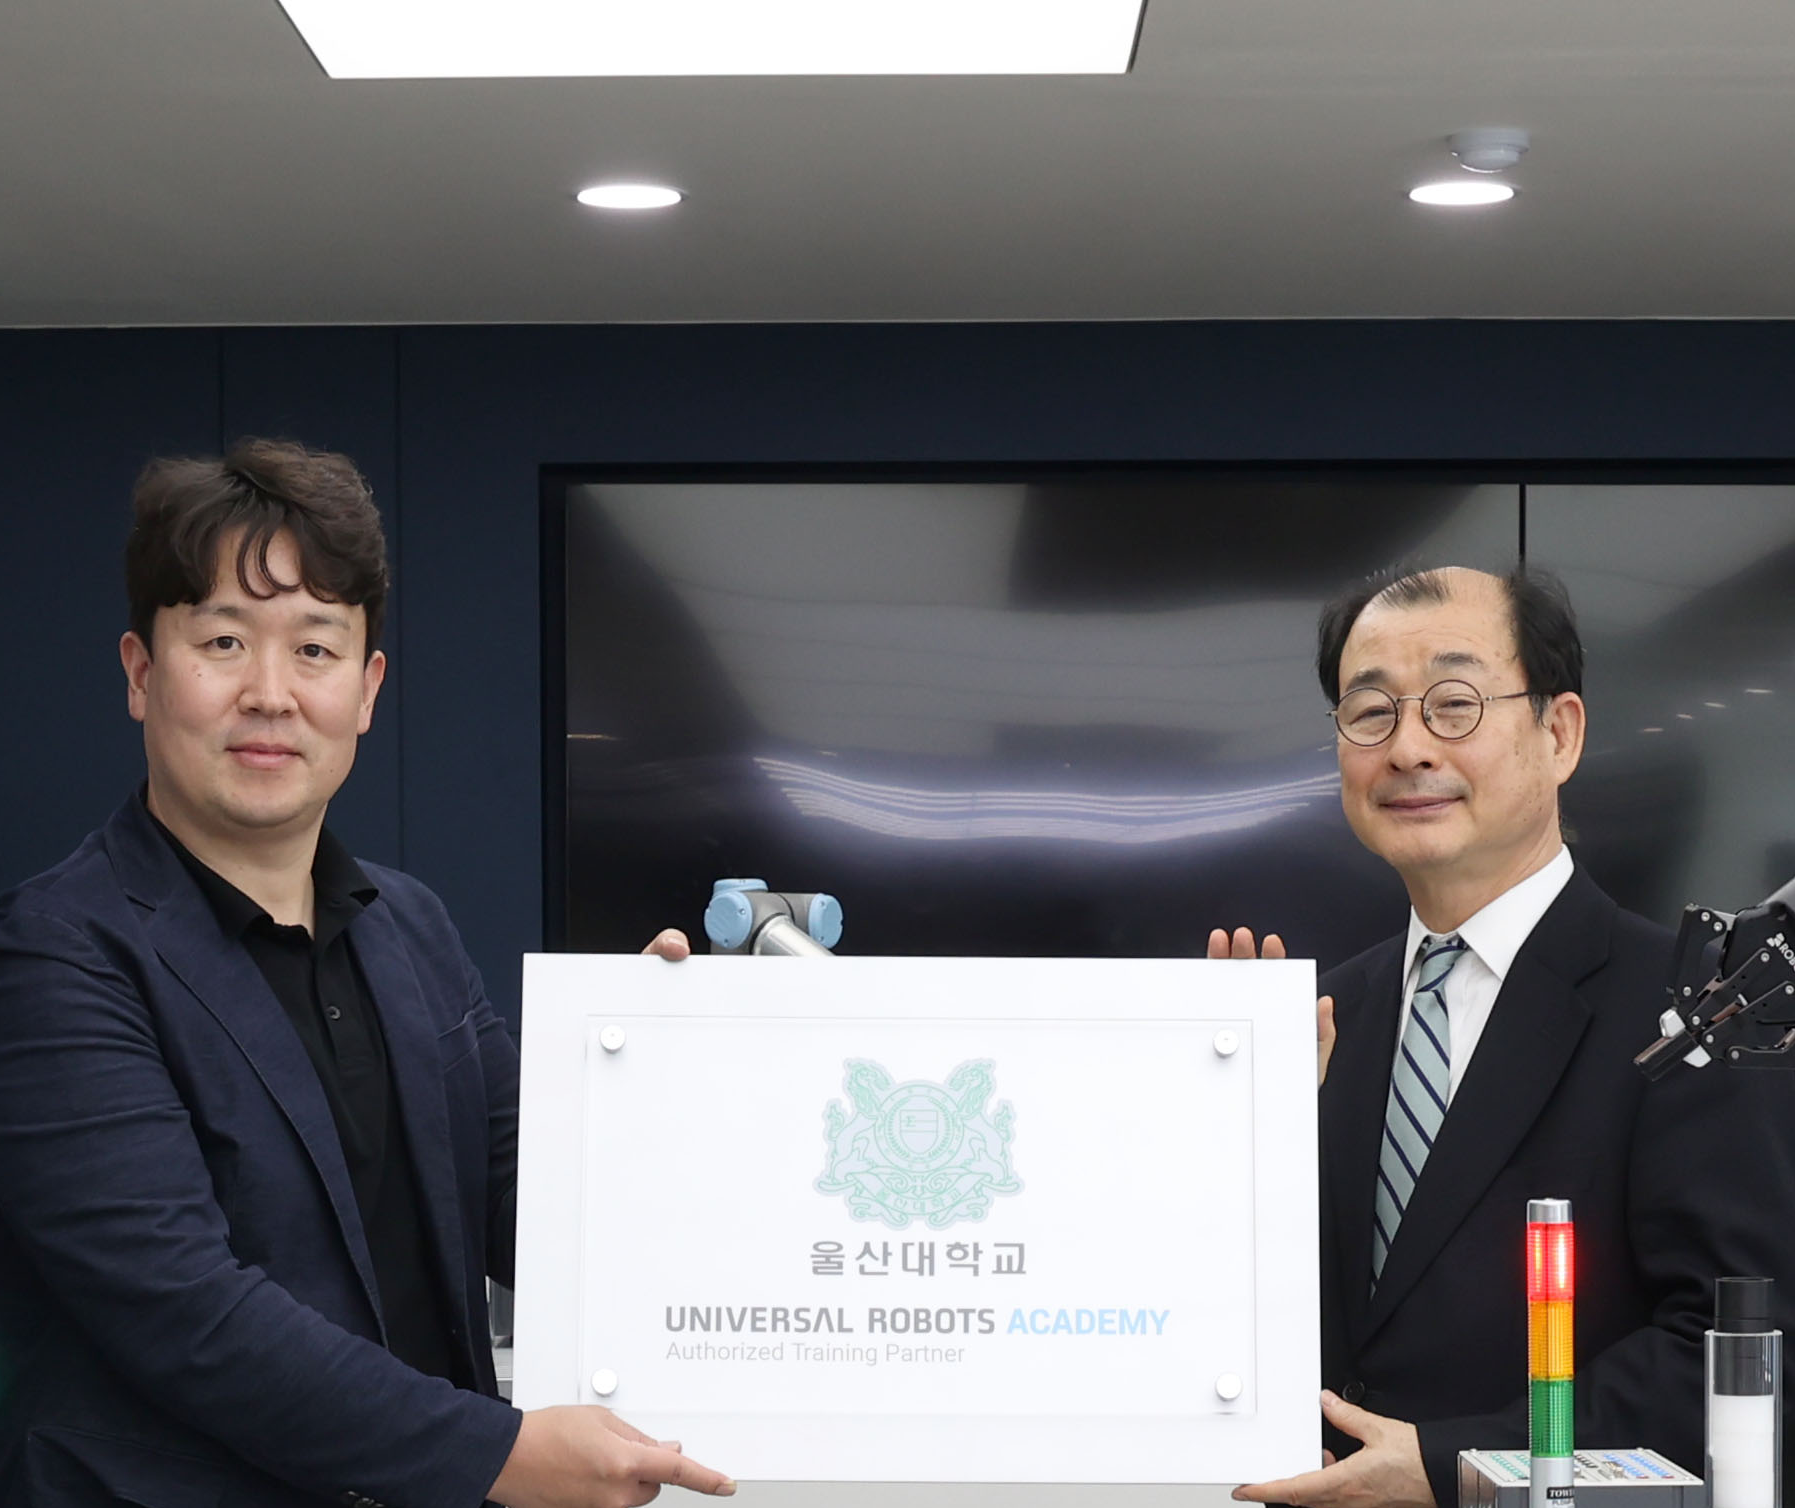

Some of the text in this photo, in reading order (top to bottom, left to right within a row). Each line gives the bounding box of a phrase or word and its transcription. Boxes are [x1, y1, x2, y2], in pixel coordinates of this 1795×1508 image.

[810, 1240, 1027, 1277] 울산대학교
[665, 1306, 1171, 1335] UNIVERSAL ROBOTS ACADEMY
[665, 1340, 965, 1367] Authorized Training Partner
